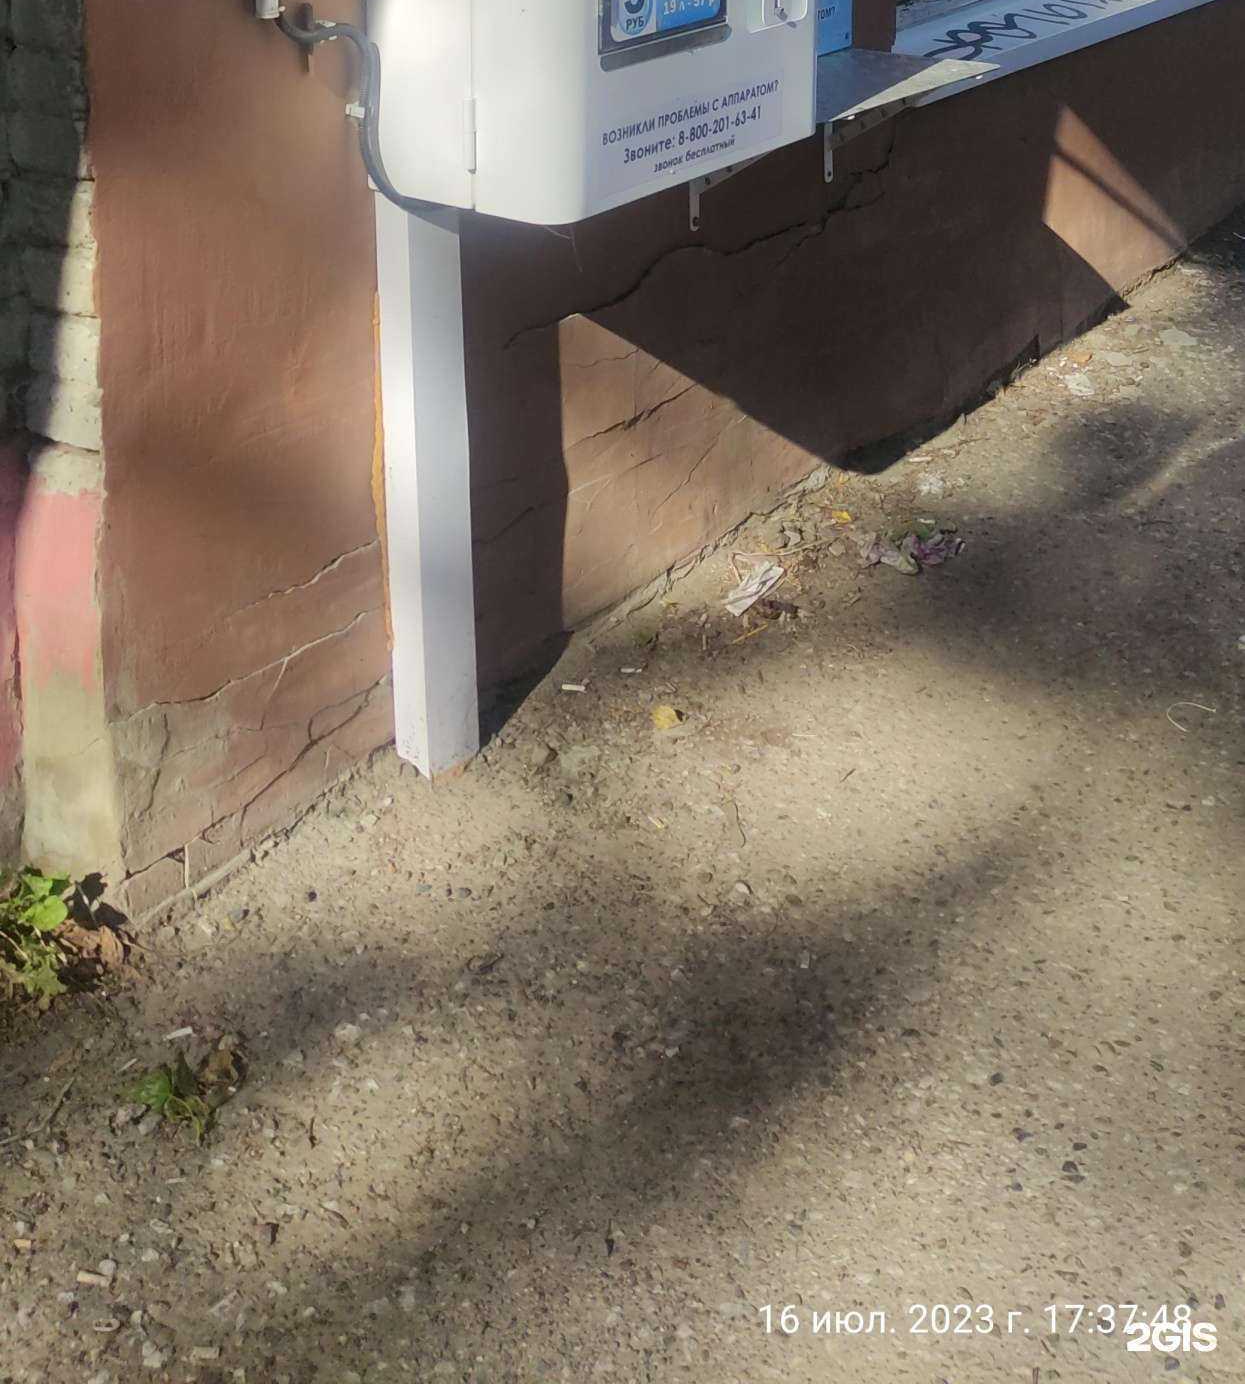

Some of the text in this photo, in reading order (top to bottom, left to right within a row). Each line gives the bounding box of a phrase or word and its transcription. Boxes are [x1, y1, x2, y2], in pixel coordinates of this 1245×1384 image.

[625, 16, 645, 30] РУБ
[663, 0, 677, 16] 19
[679, 0, 686, 12] л
[602, 79, 779, 146] ВОЗНИКЛИ ПРОБЛЕМЫ С АППАРАТОМ?
[623, 105, 762, 164] Звоните: 8-800-201-63-41
[653, 134, 736, 173] звонок бесплатный
